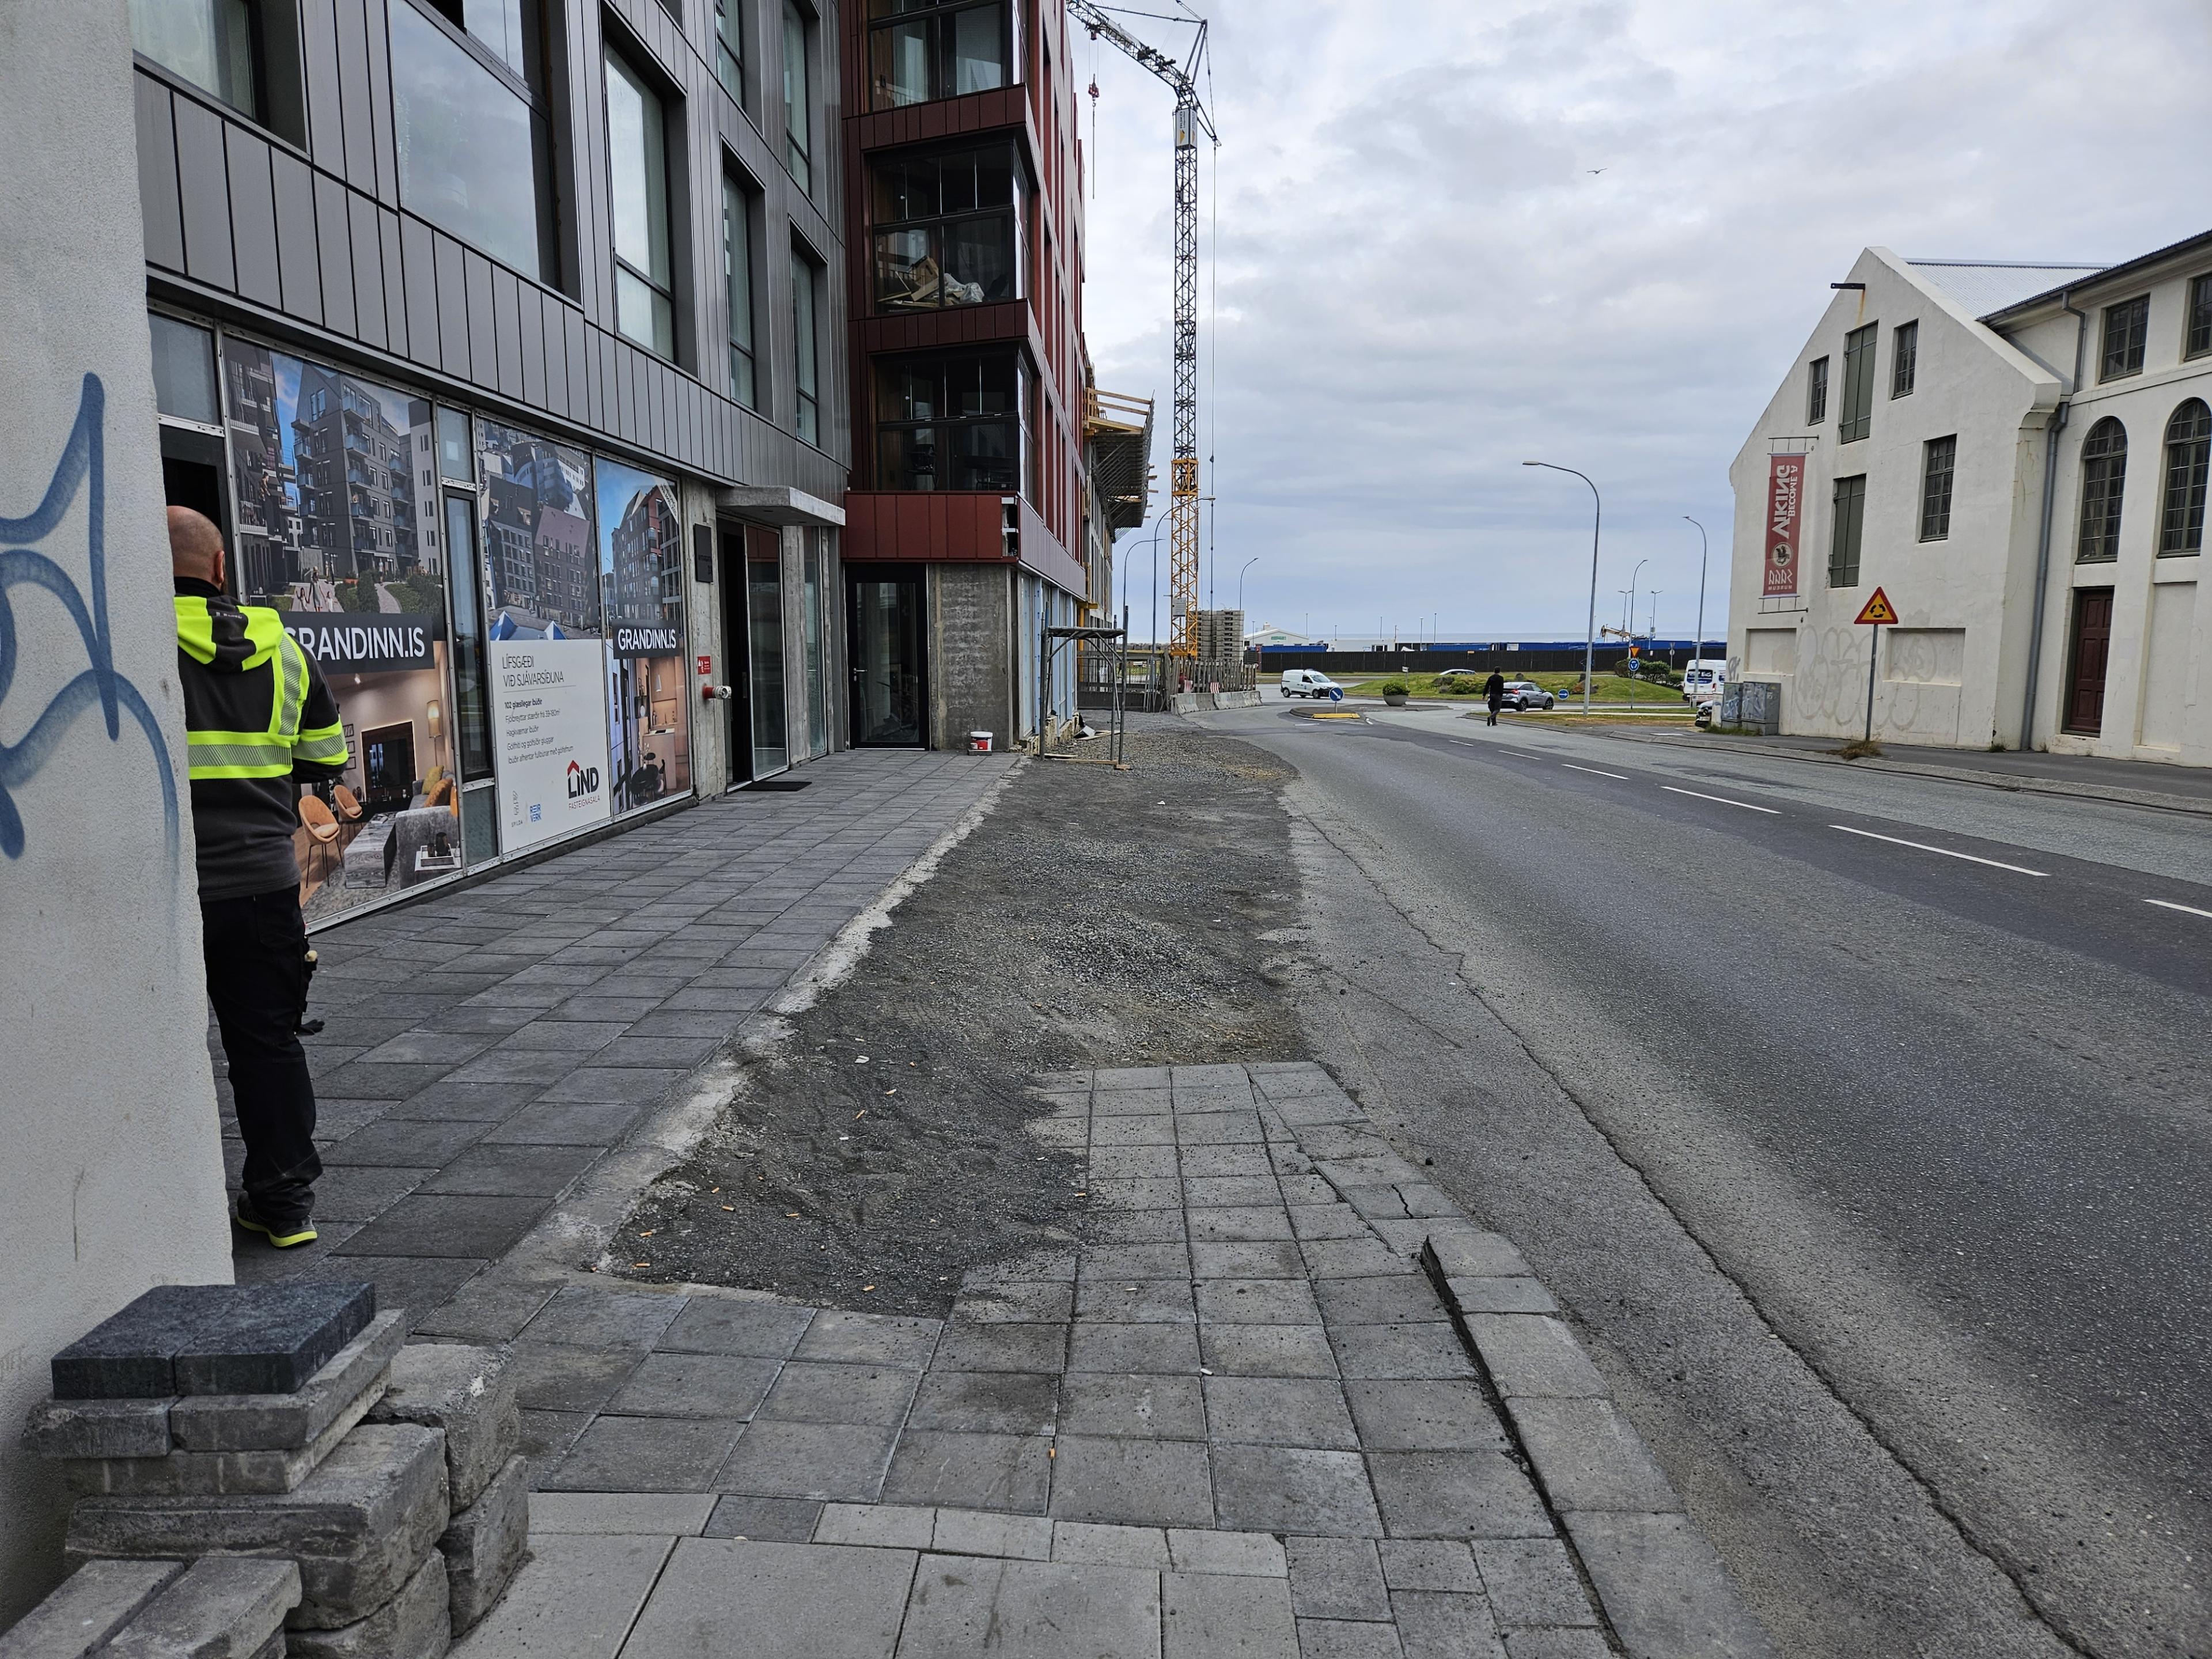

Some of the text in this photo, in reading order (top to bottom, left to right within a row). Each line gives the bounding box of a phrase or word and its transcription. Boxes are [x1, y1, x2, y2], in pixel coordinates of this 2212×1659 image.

[618, 628, 676, 651] GRANDINN.IS
[502, 653, 535, 669] LÍFSGÆÐI
[503, 669, 565, 687] VIÐ SJÁVARSÍÐUNA
[567, 767, 599, 799] LIND
[569, 795, 600, 810] FASTEIGNASALA
